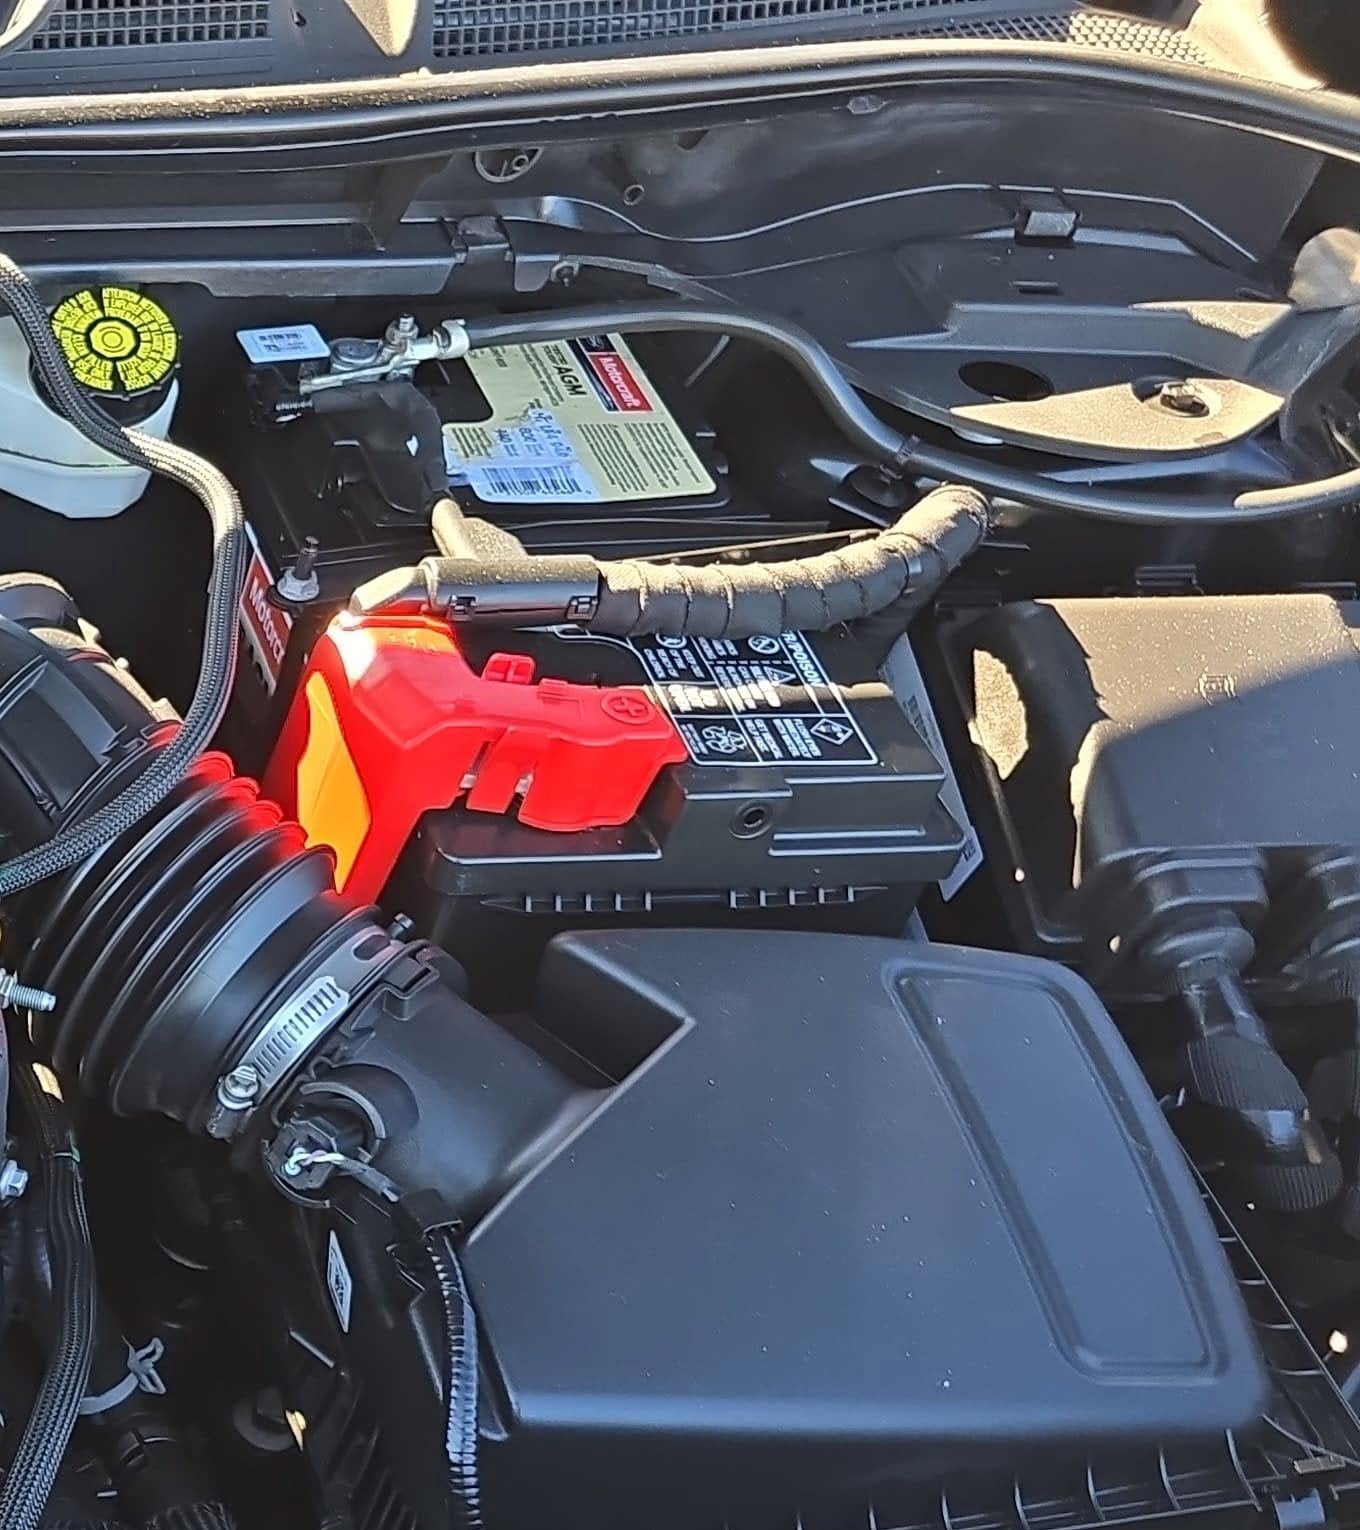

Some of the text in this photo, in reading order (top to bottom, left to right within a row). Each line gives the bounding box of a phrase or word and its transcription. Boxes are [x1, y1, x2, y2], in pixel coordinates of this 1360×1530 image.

[552, 365, 587, 396] AGM
[599, 355, 641, 408] Motorcraft
[781, 631, 825, 688] R/POISON
